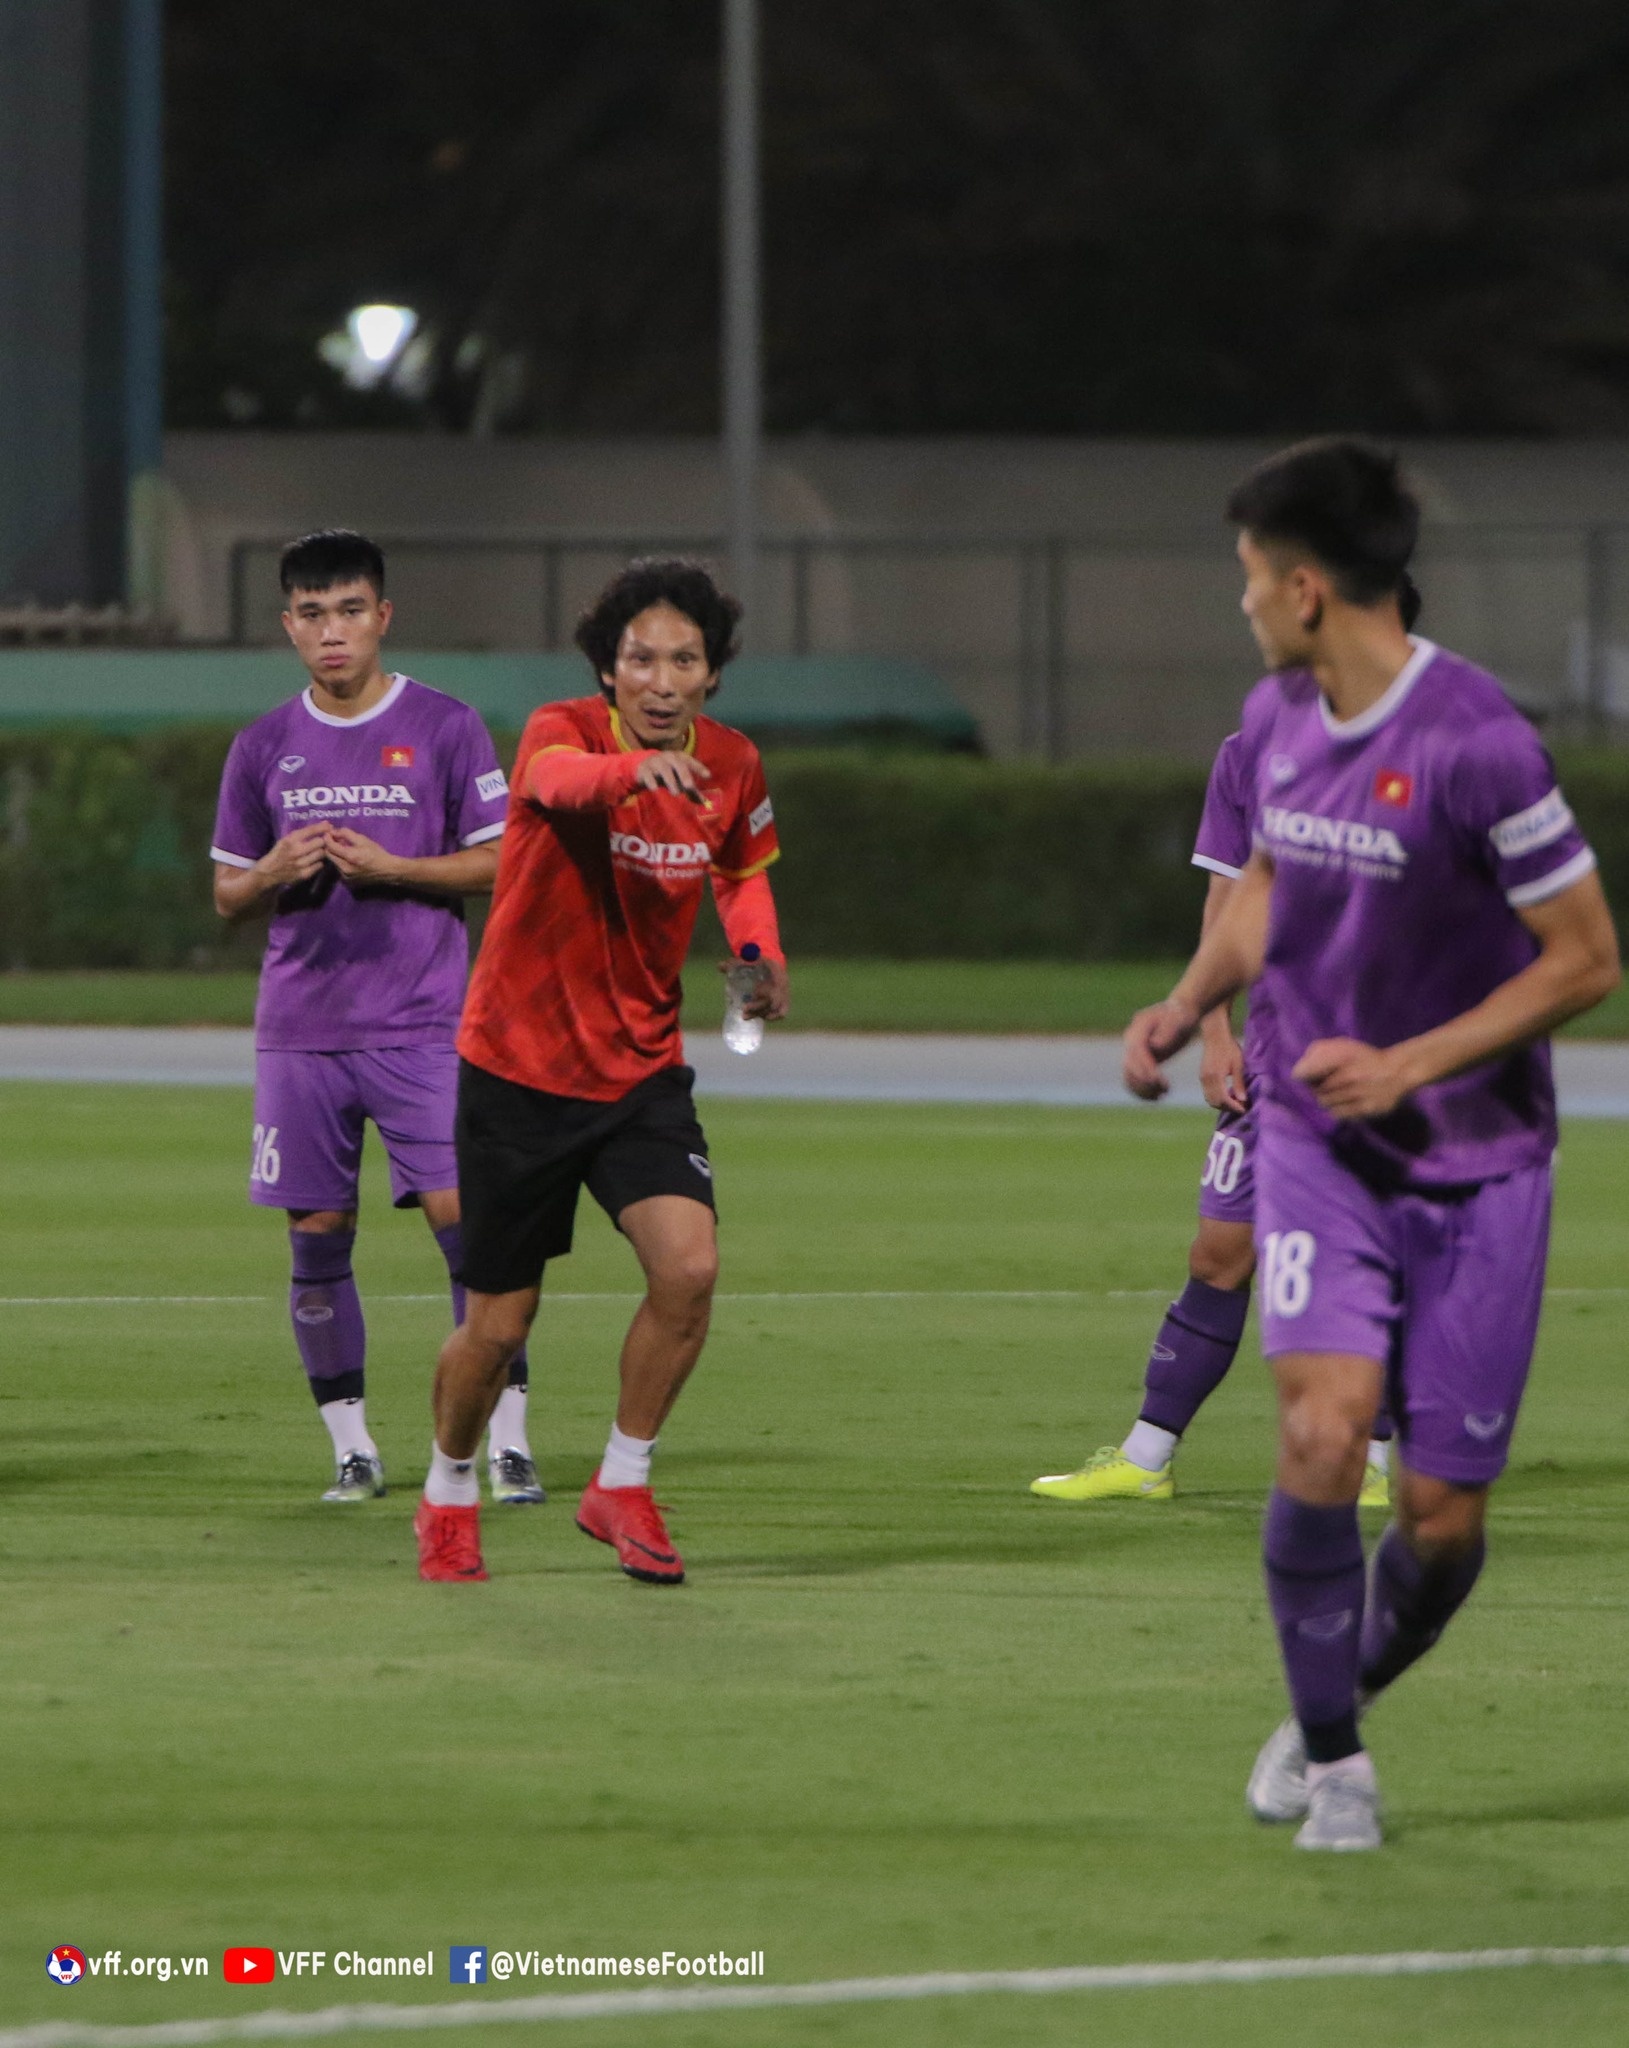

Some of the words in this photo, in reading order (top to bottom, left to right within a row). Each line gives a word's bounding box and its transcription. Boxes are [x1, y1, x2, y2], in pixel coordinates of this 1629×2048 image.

[281, 784, 416, 809] HONDA
[288, 811, 309, 822] The
[309, 808, 346, 819] Power
[347, 807, 361, 817] of
[363, 806, 410, 818] Dreams
[1262, 805, 1409, 865] HONDA
[1201, 1130, 1245, 1193] 50
[1263, 1229, 1317, 1319] 18
